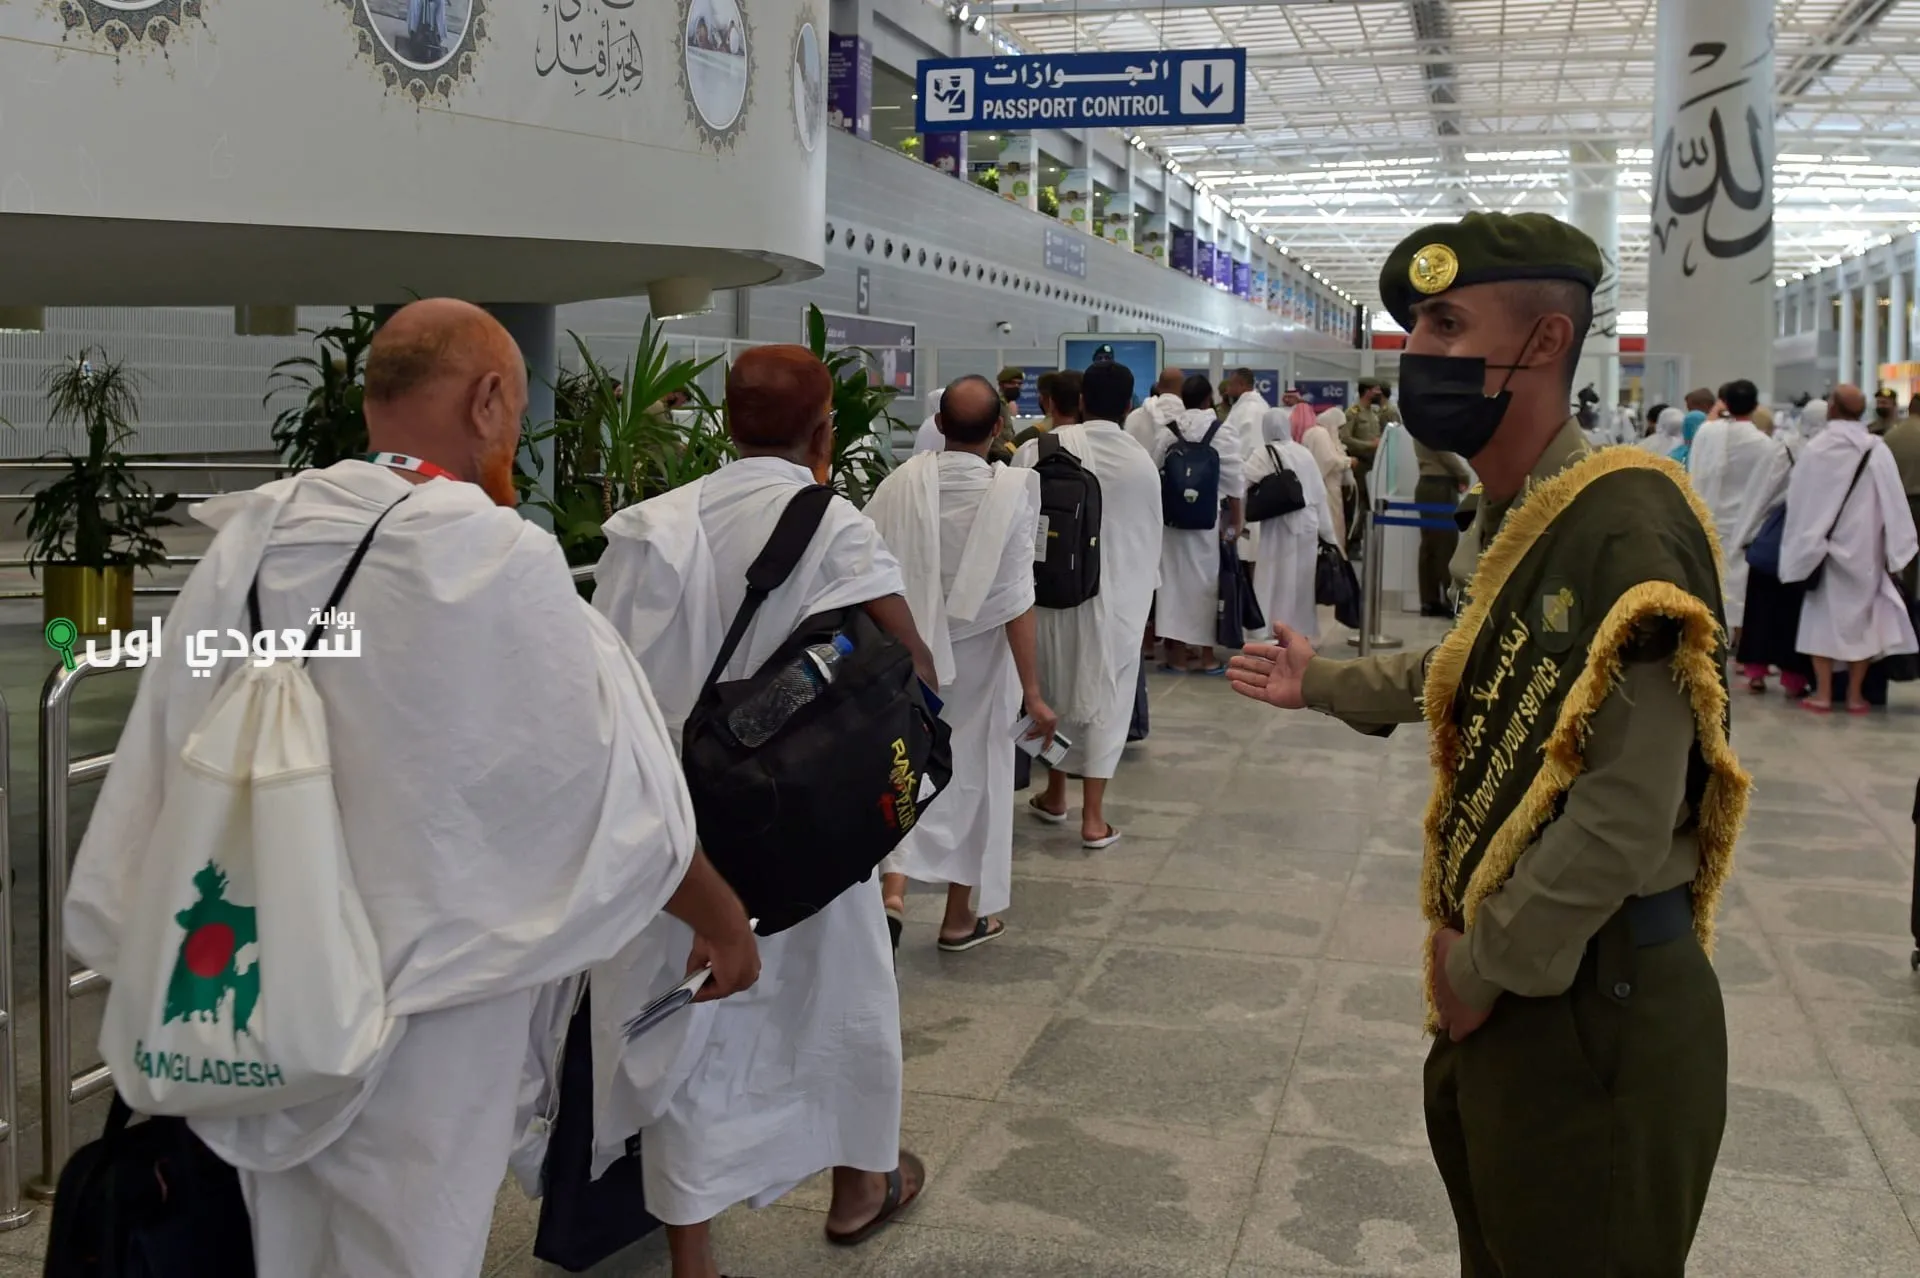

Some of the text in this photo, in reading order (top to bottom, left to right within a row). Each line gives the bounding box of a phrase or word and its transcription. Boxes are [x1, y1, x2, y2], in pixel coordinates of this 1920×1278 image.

[984, 59, 1170, 89] الجوازات
[982, 94, 1170, 120] PASSPORT CONTROL
[859, 275, 868, 309] 5
[1321, 384, 1344, 397] stc
[1459, 762, 1500, 832] Airport
[1488, 745, 1508, 779] at
[1500, 710, 1530, 770] your
[1518, 657, 1561, 724] service
